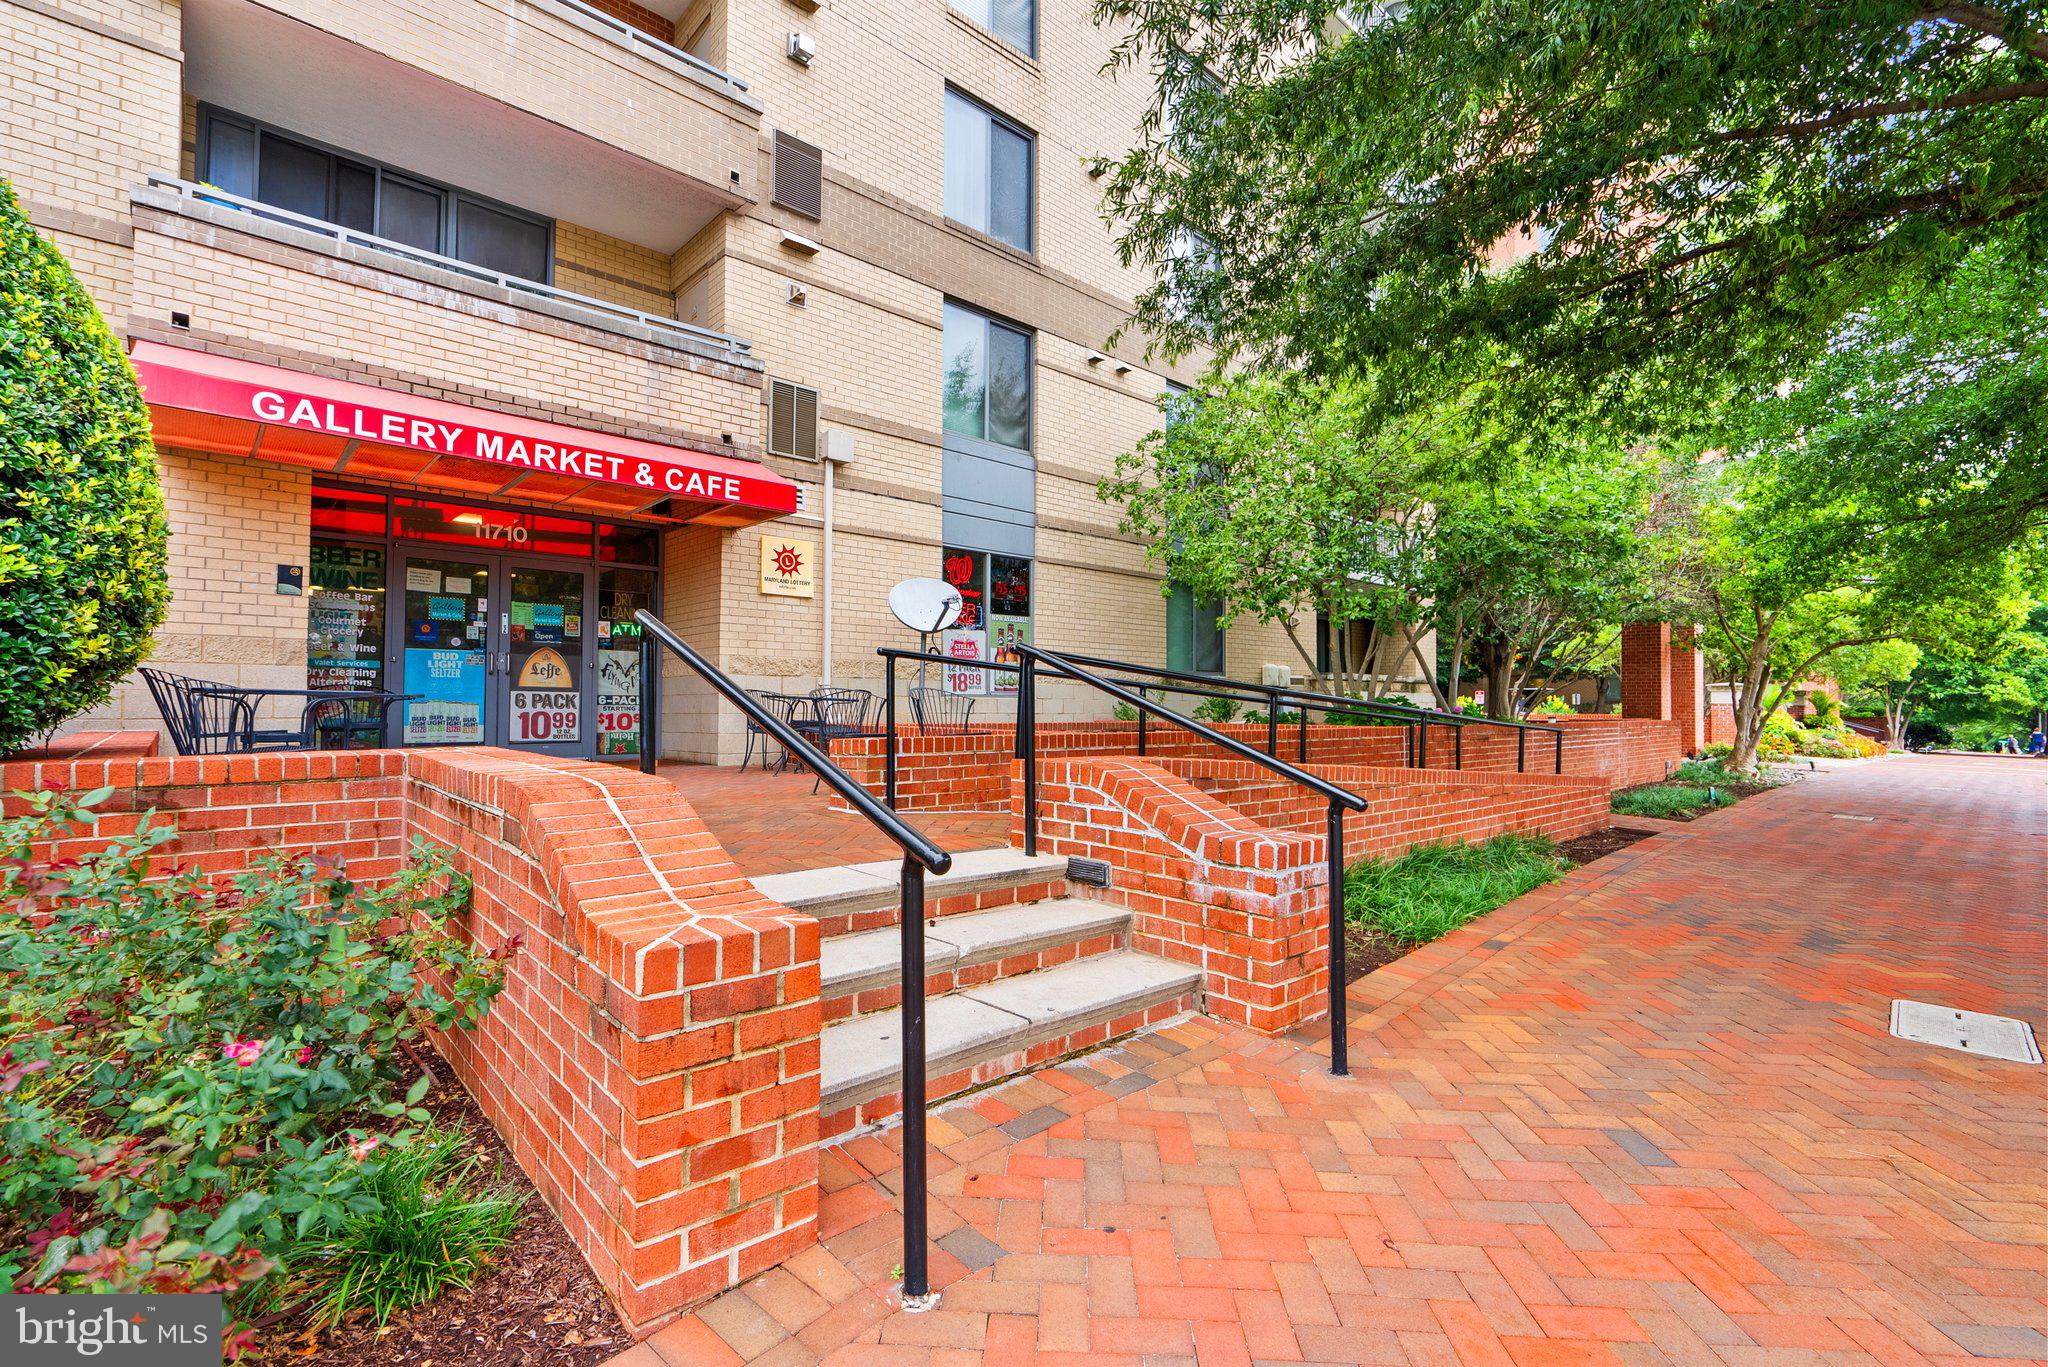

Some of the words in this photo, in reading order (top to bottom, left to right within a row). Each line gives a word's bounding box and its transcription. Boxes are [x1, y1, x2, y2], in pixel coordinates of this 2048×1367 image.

[251, 390, 463, 452] GALLERY
[475, 431, 625, 480] MARKET
[634, 462, 656, 487] &
[664, 467, 741, 501] CAFE
[473, 522, 528, 543] 11710
[310, 545, 382, 568] BEER
[310, 564, 379, 589] WINE
[763, 576, 790, 585] MARYLAND
[790, 579, 811, 587] LOTTERY
[313, 590, 351, 600] Coffee
[354, 592, 374, 602] Bar
[614, 592, 634, 606] DRY
[600, 605, 635, 620] CLEAN
[318, 616, 367, 626] Gourmet
[320, 626, 364, 638] Grocery
[611, 624, 642, 637] ATM
[308, 642, 333, 651] Beer
[337, 643, 345, 652] &
[349, 643, 377, 653] Wine
[432, 652, 459, 660] BUD
[427, 660, 464, 669] LIGHT
[329, 668, 377, 679] Cleaning
[430, 668, 461, 678] SELTZER
[530, 662, 561, 680] Leffe
[309, 678, 373, 687] Alterations
[600, 662, 631, 694] FLYING
[514, 692, 527, 709] 6
[531, 693, 578, 710] PACK
[598, 695, 640, 705] 6-PAC
